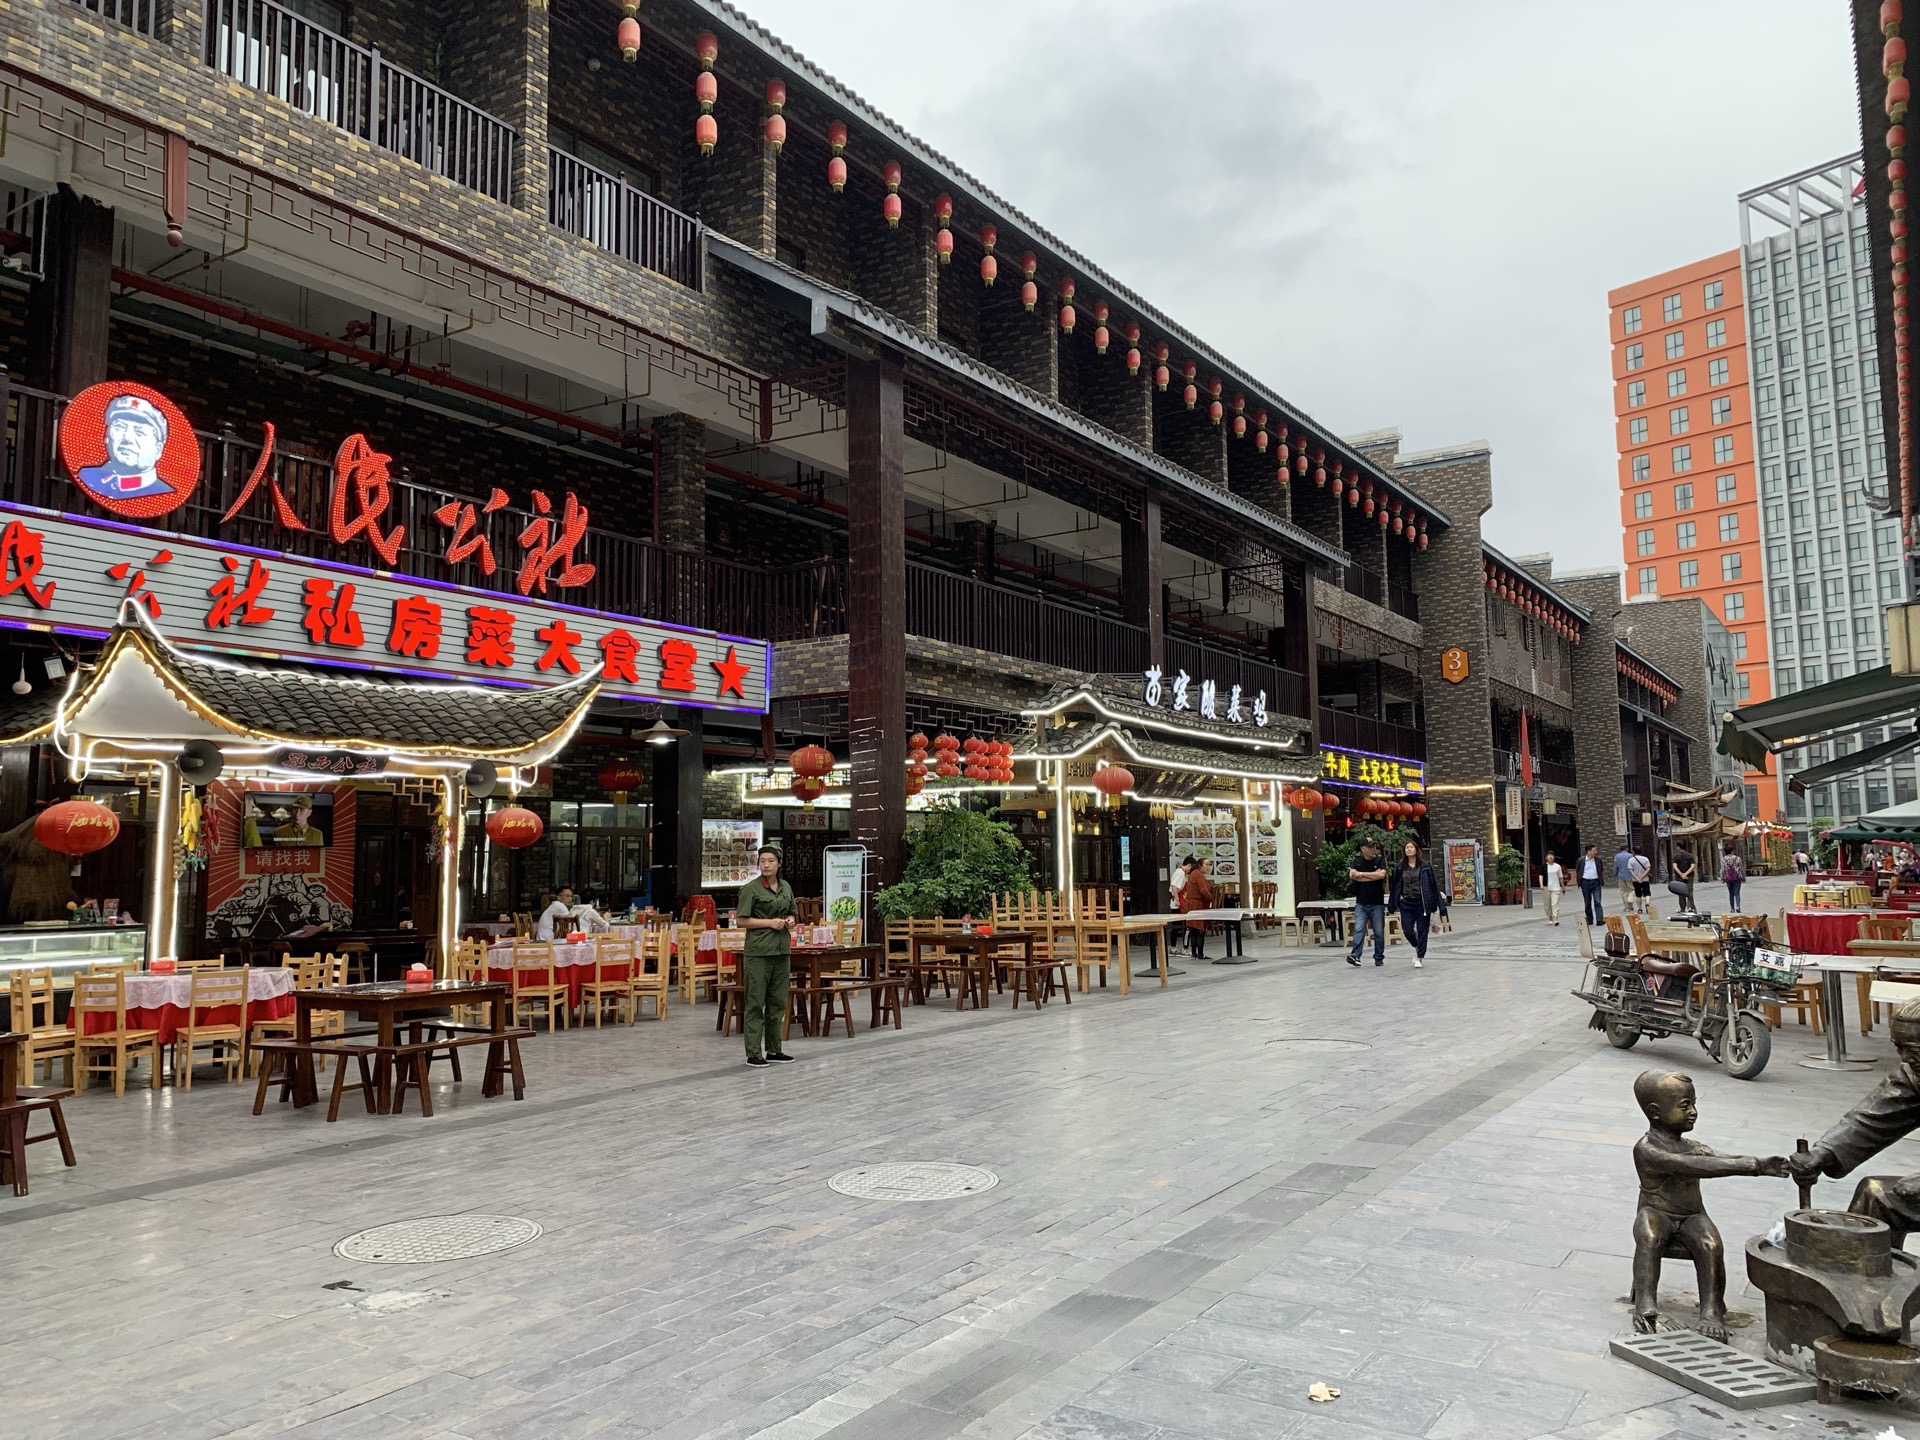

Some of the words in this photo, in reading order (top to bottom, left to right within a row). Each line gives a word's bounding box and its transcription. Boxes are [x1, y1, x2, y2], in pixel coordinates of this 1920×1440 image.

[219, 421, 596, 596] 人民公社
[1449, 651, 1461, 670] 3
[282, 753, 377, 774] 鄂西公社
[1320, 751, 1350, 781] 牛肉
[1358, 758, 1401, 787] 土家名菜
[788, 813, 826, 827] 空调开放
[255, 849, 311, 867] 请找我
